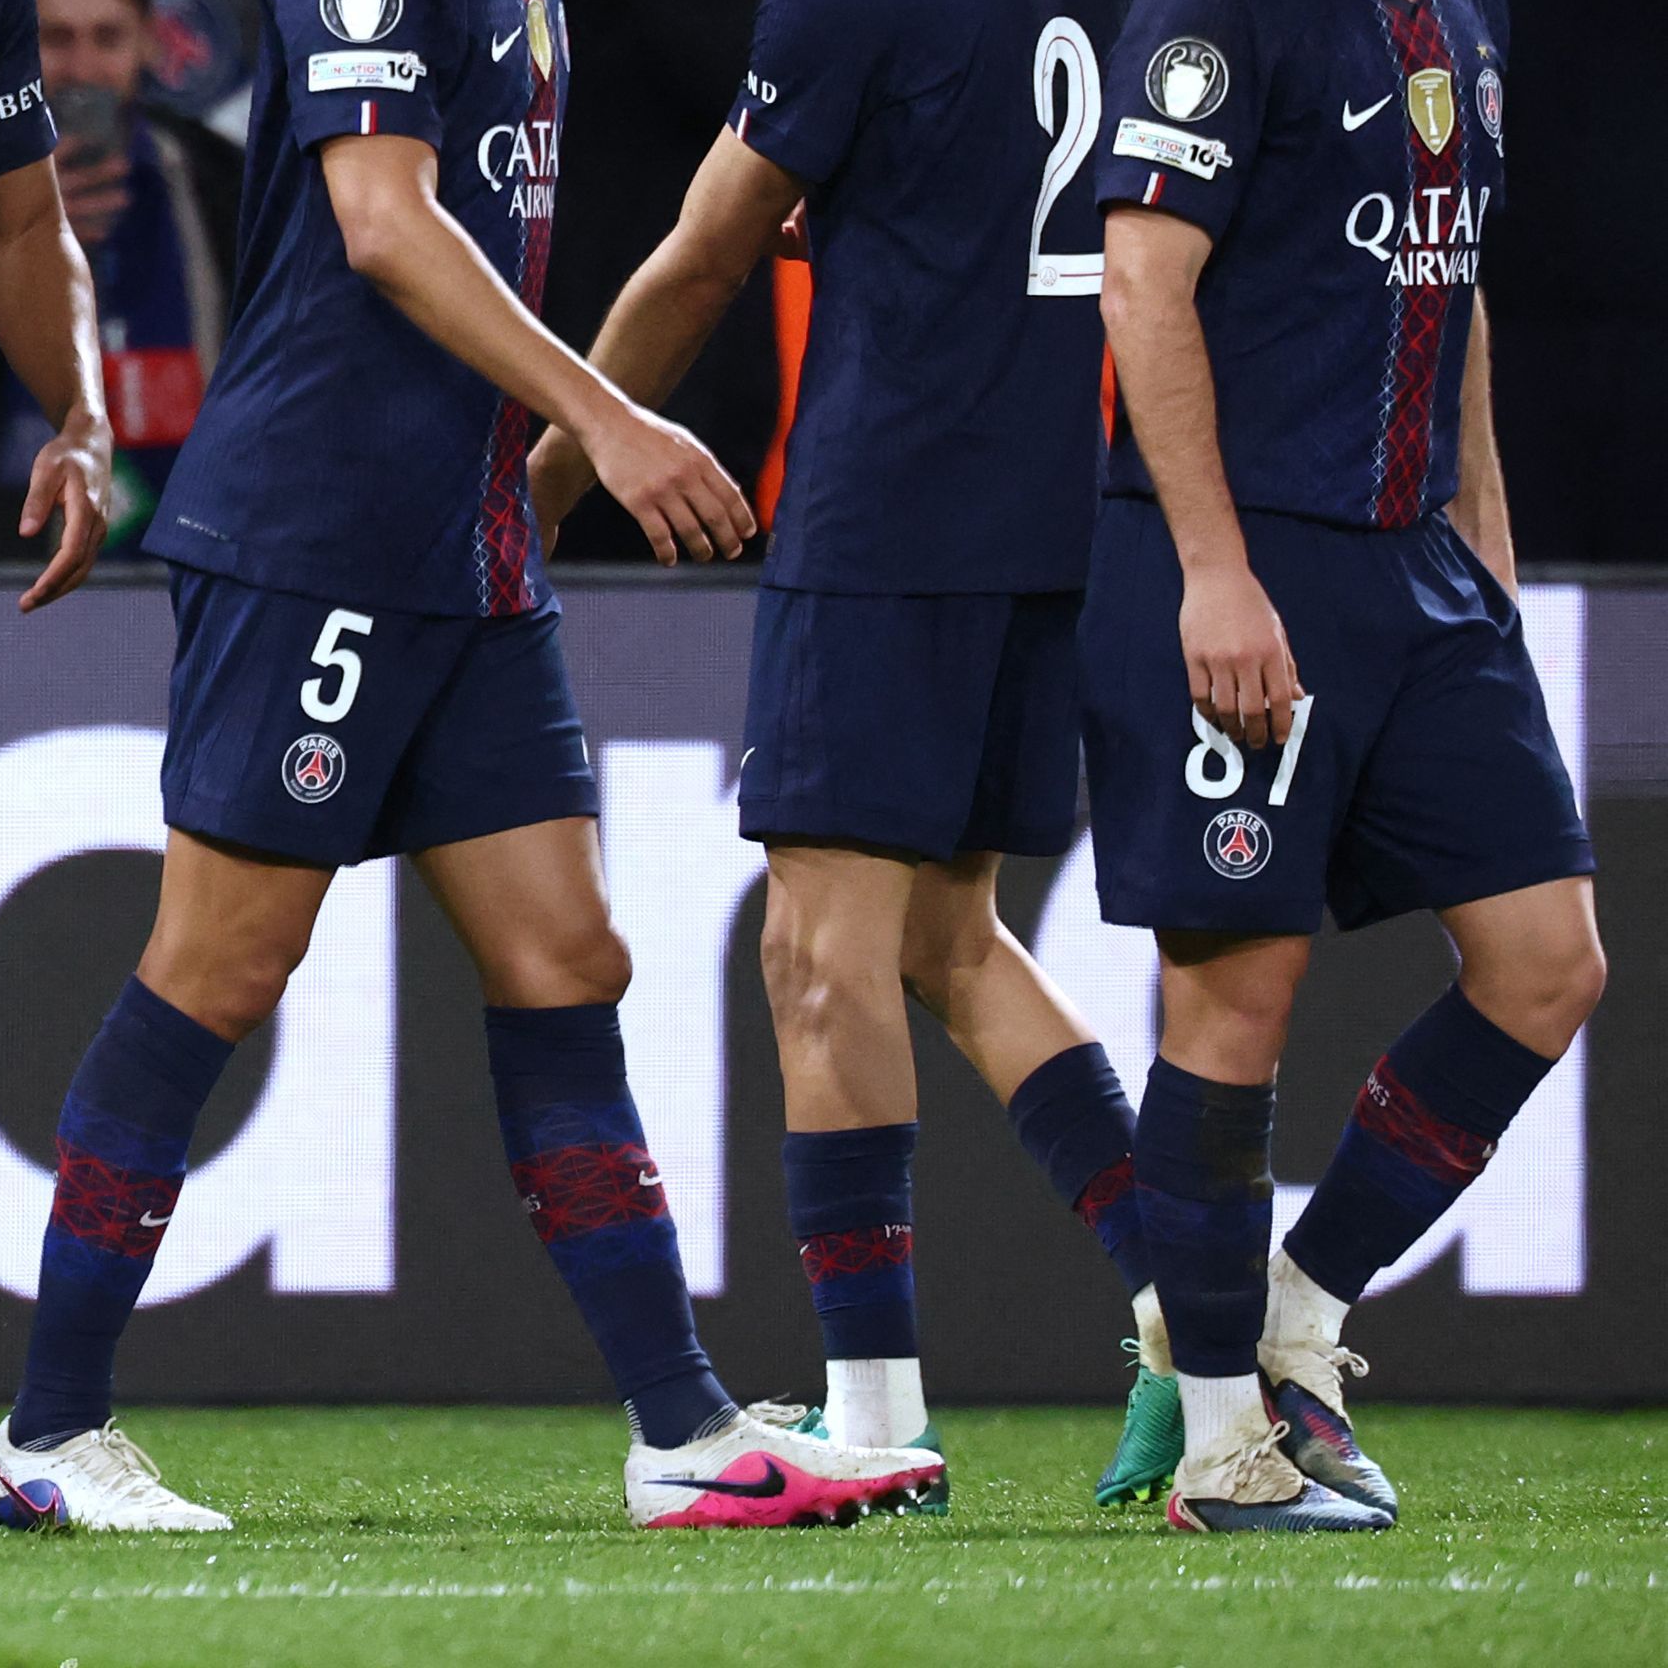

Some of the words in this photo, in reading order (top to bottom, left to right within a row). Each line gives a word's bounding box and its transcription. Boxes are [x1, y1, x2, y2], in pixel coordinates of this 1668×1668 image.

[1027, 16, 1105, 296] 2
[300, 608, 374, 723] 5
[298, 738, 339, 759] PARIS
[1184, 694, 1315, 807] 87
[1216, 813, 1261, 832] PARIS
